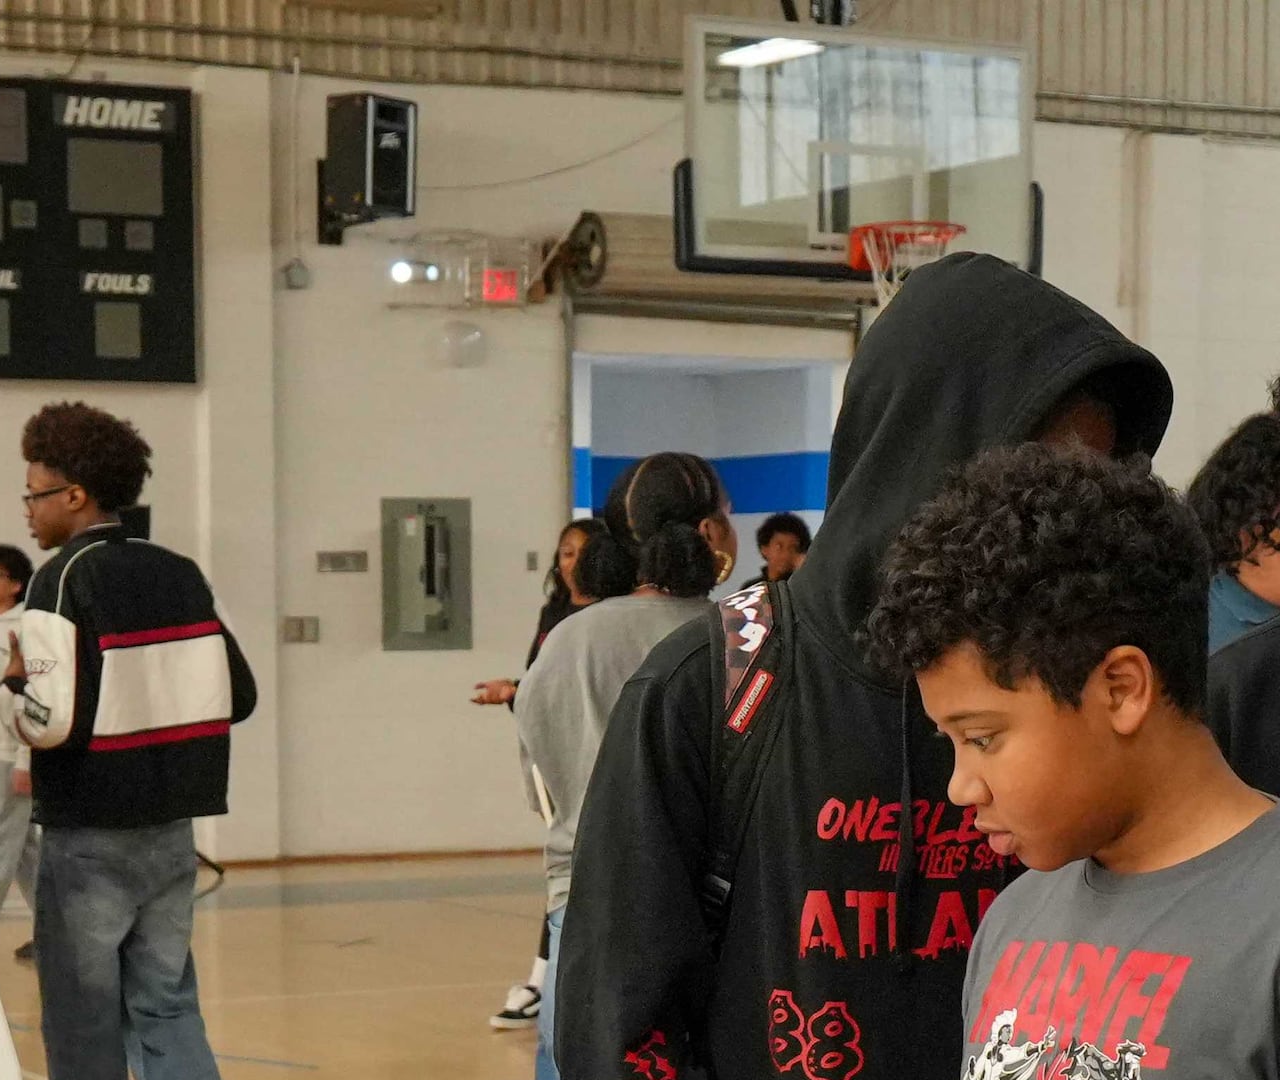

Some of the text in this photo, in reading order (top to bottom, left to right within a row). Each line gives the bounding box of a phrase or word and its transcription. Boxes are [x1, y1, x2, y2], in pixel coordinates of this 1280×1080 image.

[63, 95, 167, 131] HOME
[83, 271, 152, 295] FOULS
[970, 941, 1193, 1070] MARVEL
